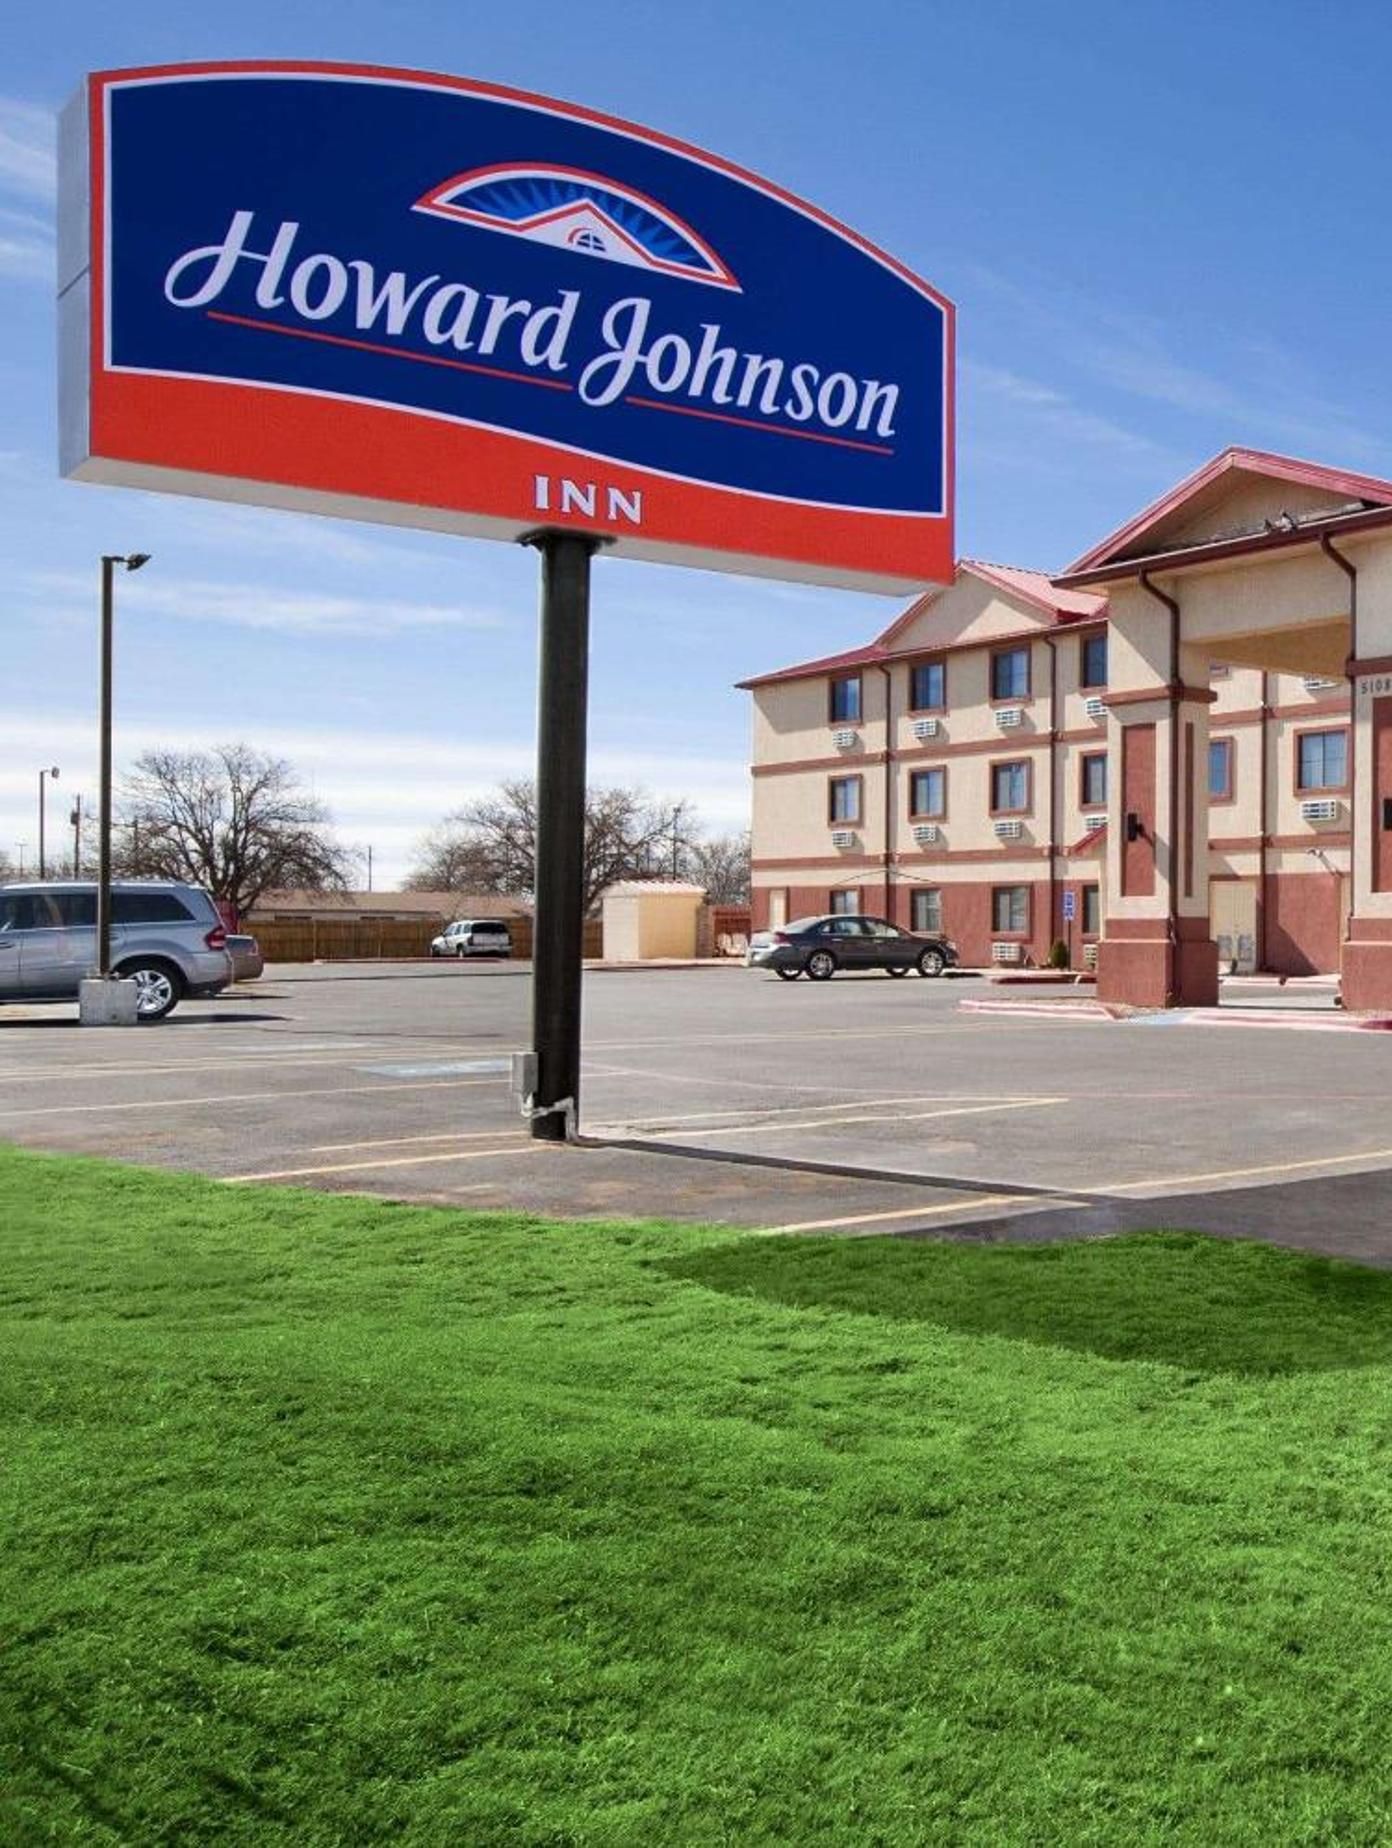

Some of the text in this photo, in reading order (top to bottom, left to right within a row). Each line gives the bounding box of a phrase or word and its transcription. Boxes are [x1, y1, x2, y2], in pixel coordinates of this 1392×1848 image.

[164, 210, 899, 437] Howard Johnson
[534, 474, 643, 524] INN
